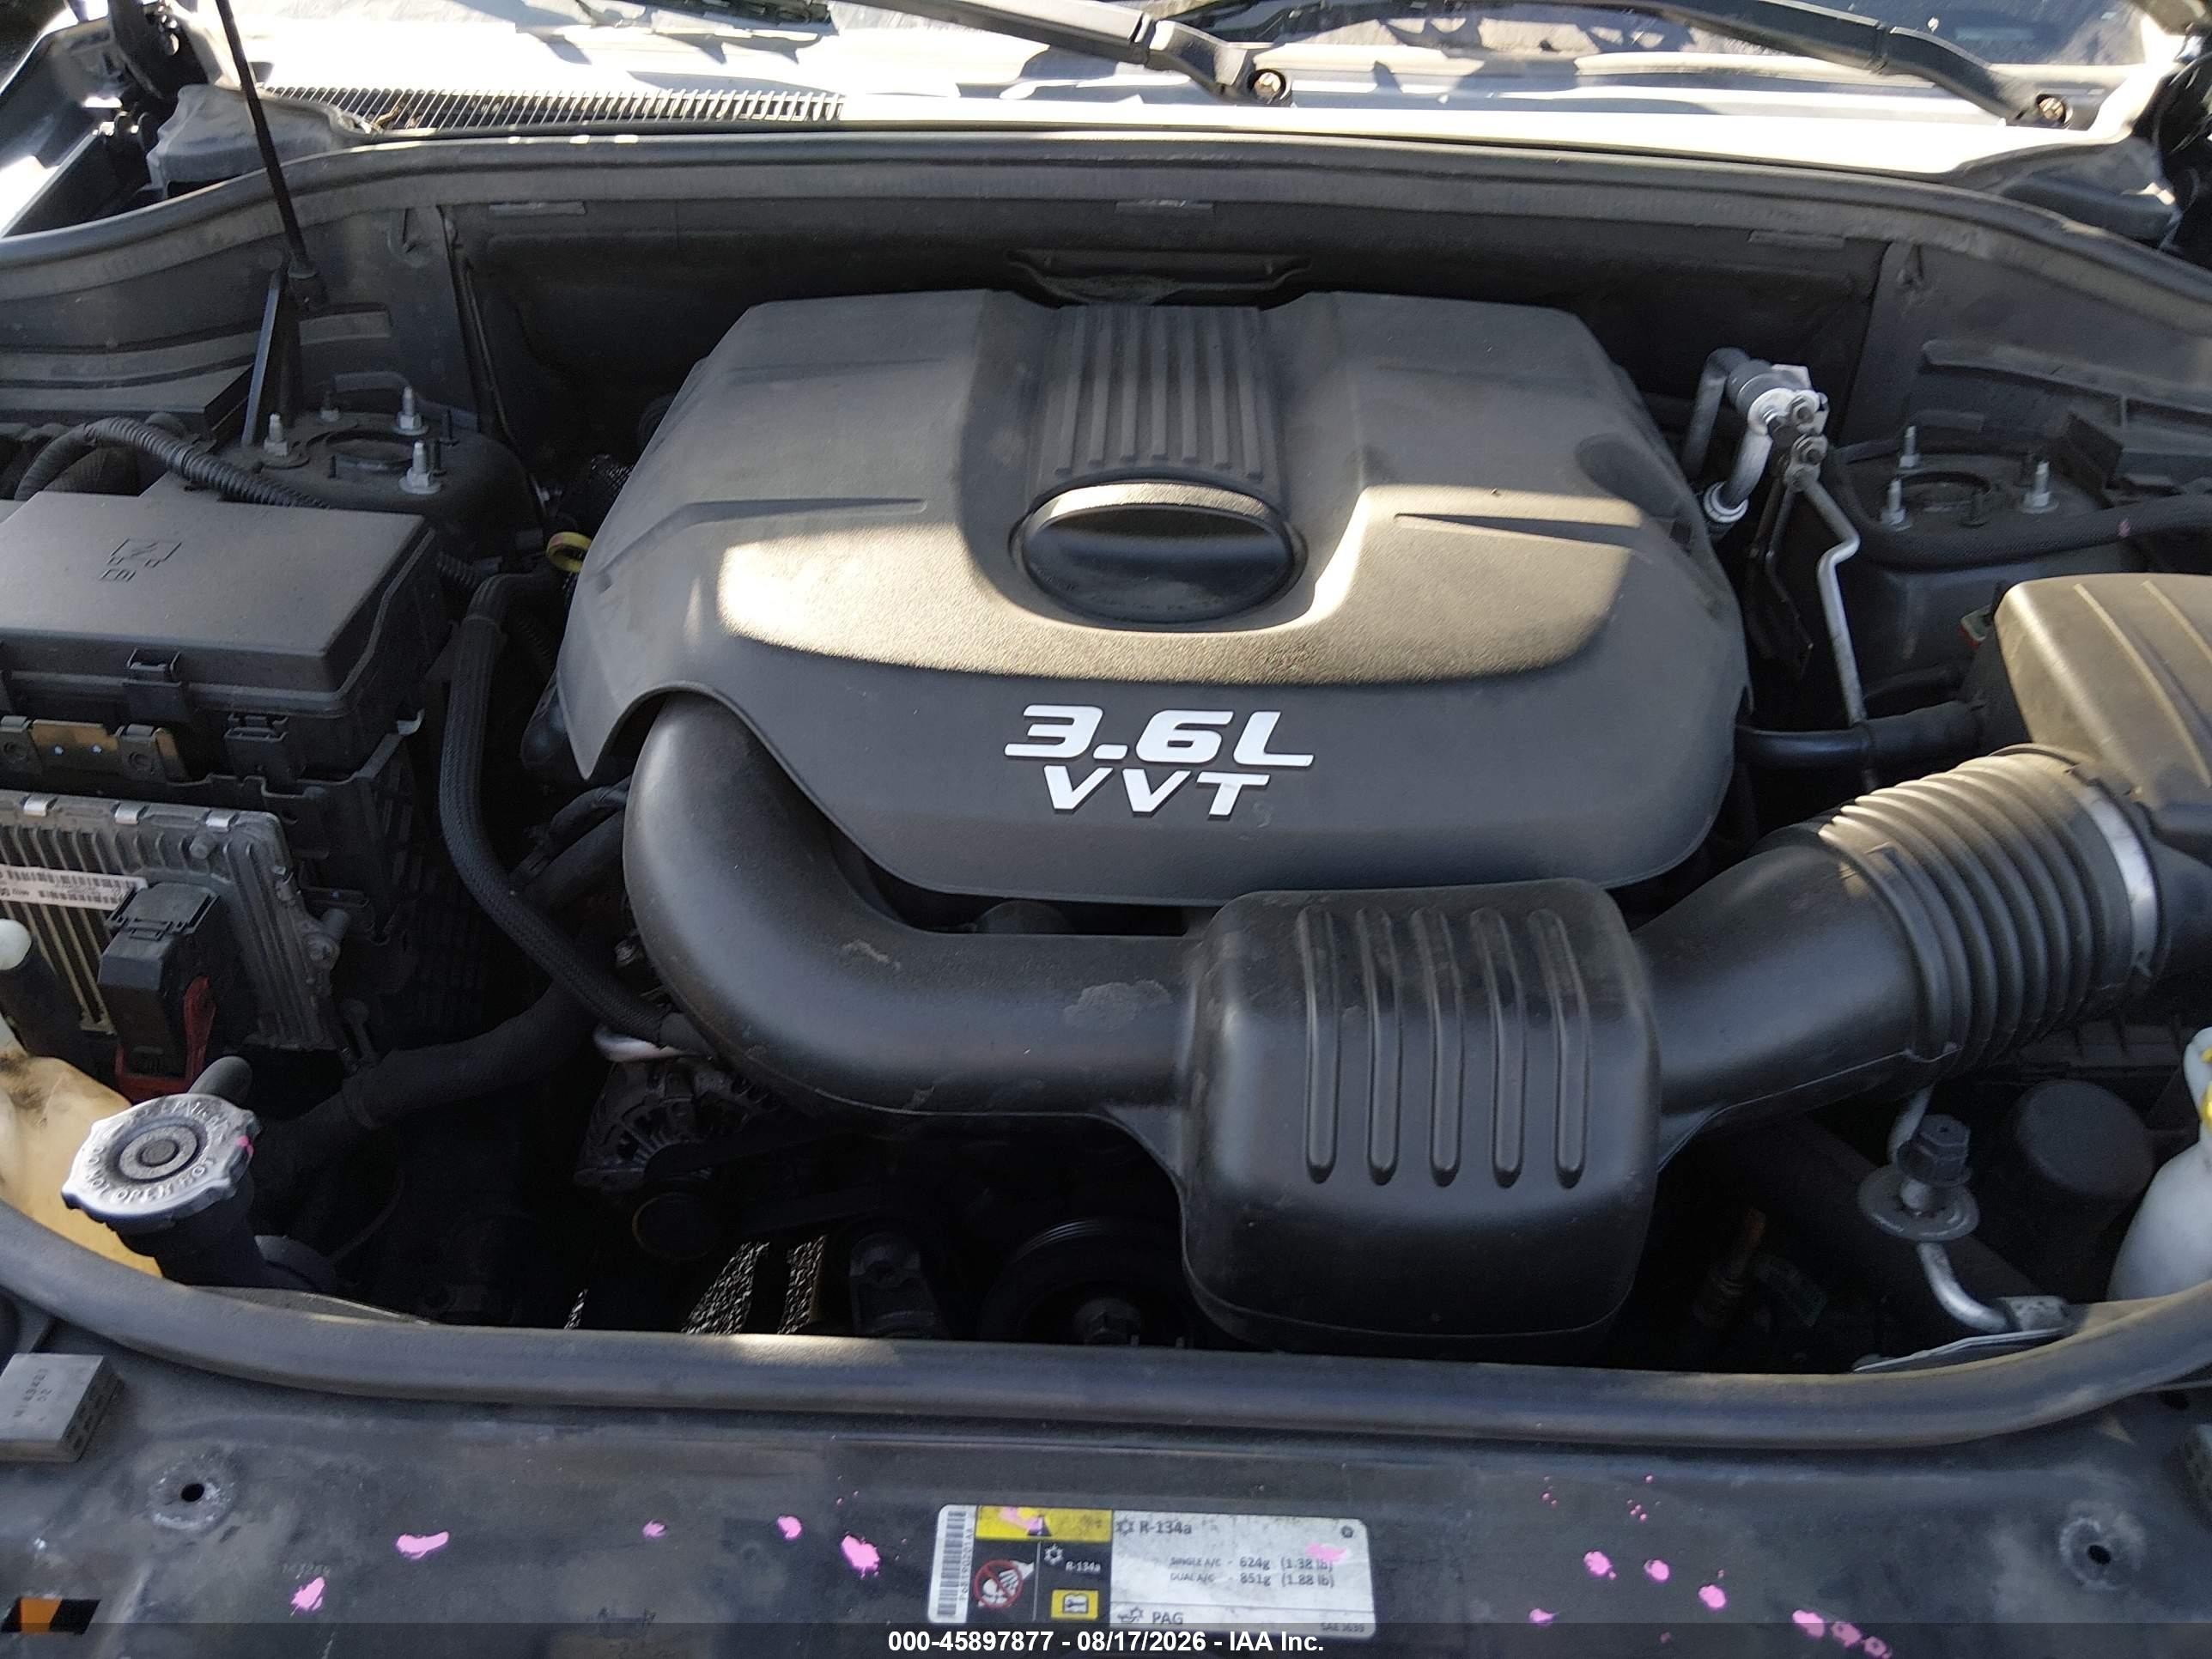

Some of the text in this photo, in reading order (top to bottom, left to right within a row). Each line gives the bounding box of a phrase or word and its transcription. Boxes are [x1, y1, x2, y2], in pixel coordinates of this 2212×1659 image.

[1003, 703, 1315, 767] 3.6L
[1042, 764, 1271, 817] VVT
[1139, 1519, 1193, 1535] R-134a
[1065, 1560, 1102, 1573] R-134a
[1239, 1556, 1271, 1571] 624g
[1239, 1571, 1272, 1587] 851g
[1152, 1611, 1184, 1625] PAG
